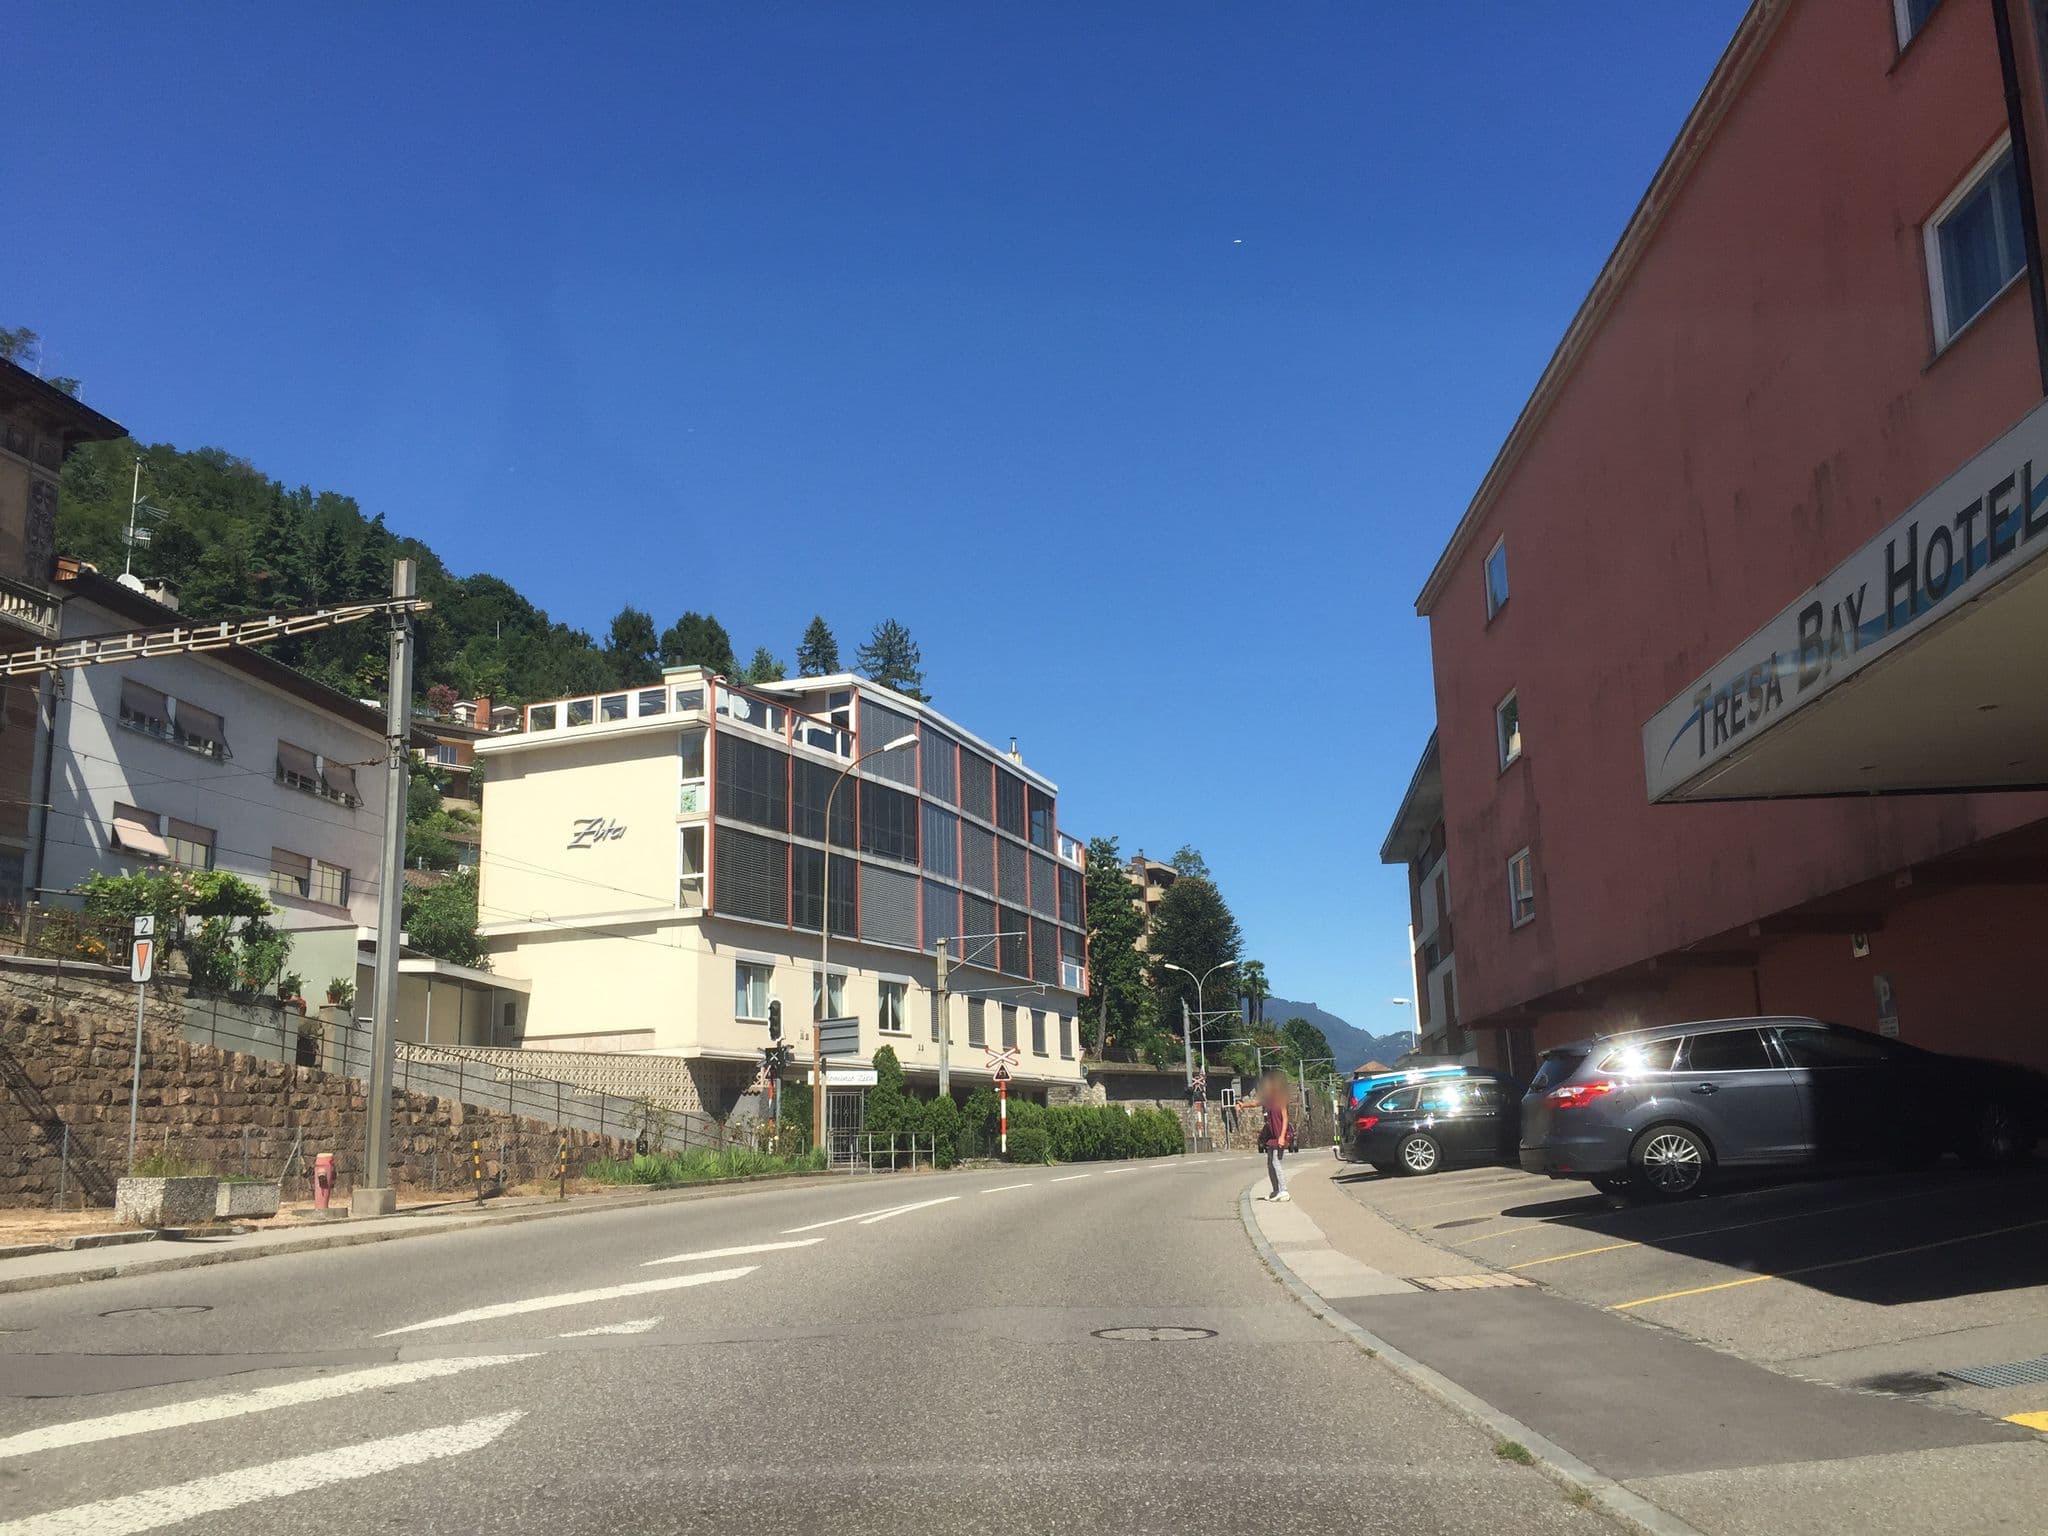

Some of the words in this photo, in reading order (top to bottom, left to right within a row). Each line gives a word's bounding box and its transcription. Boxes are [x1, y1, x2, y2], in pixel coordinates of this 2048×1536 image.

[1694, 652, 1784, 759] TRESA
[1796, 582, 1868, 695] BAY
[1884, 458, 2048, 632] HOTEL
[140, 917, 149, 934] 2
